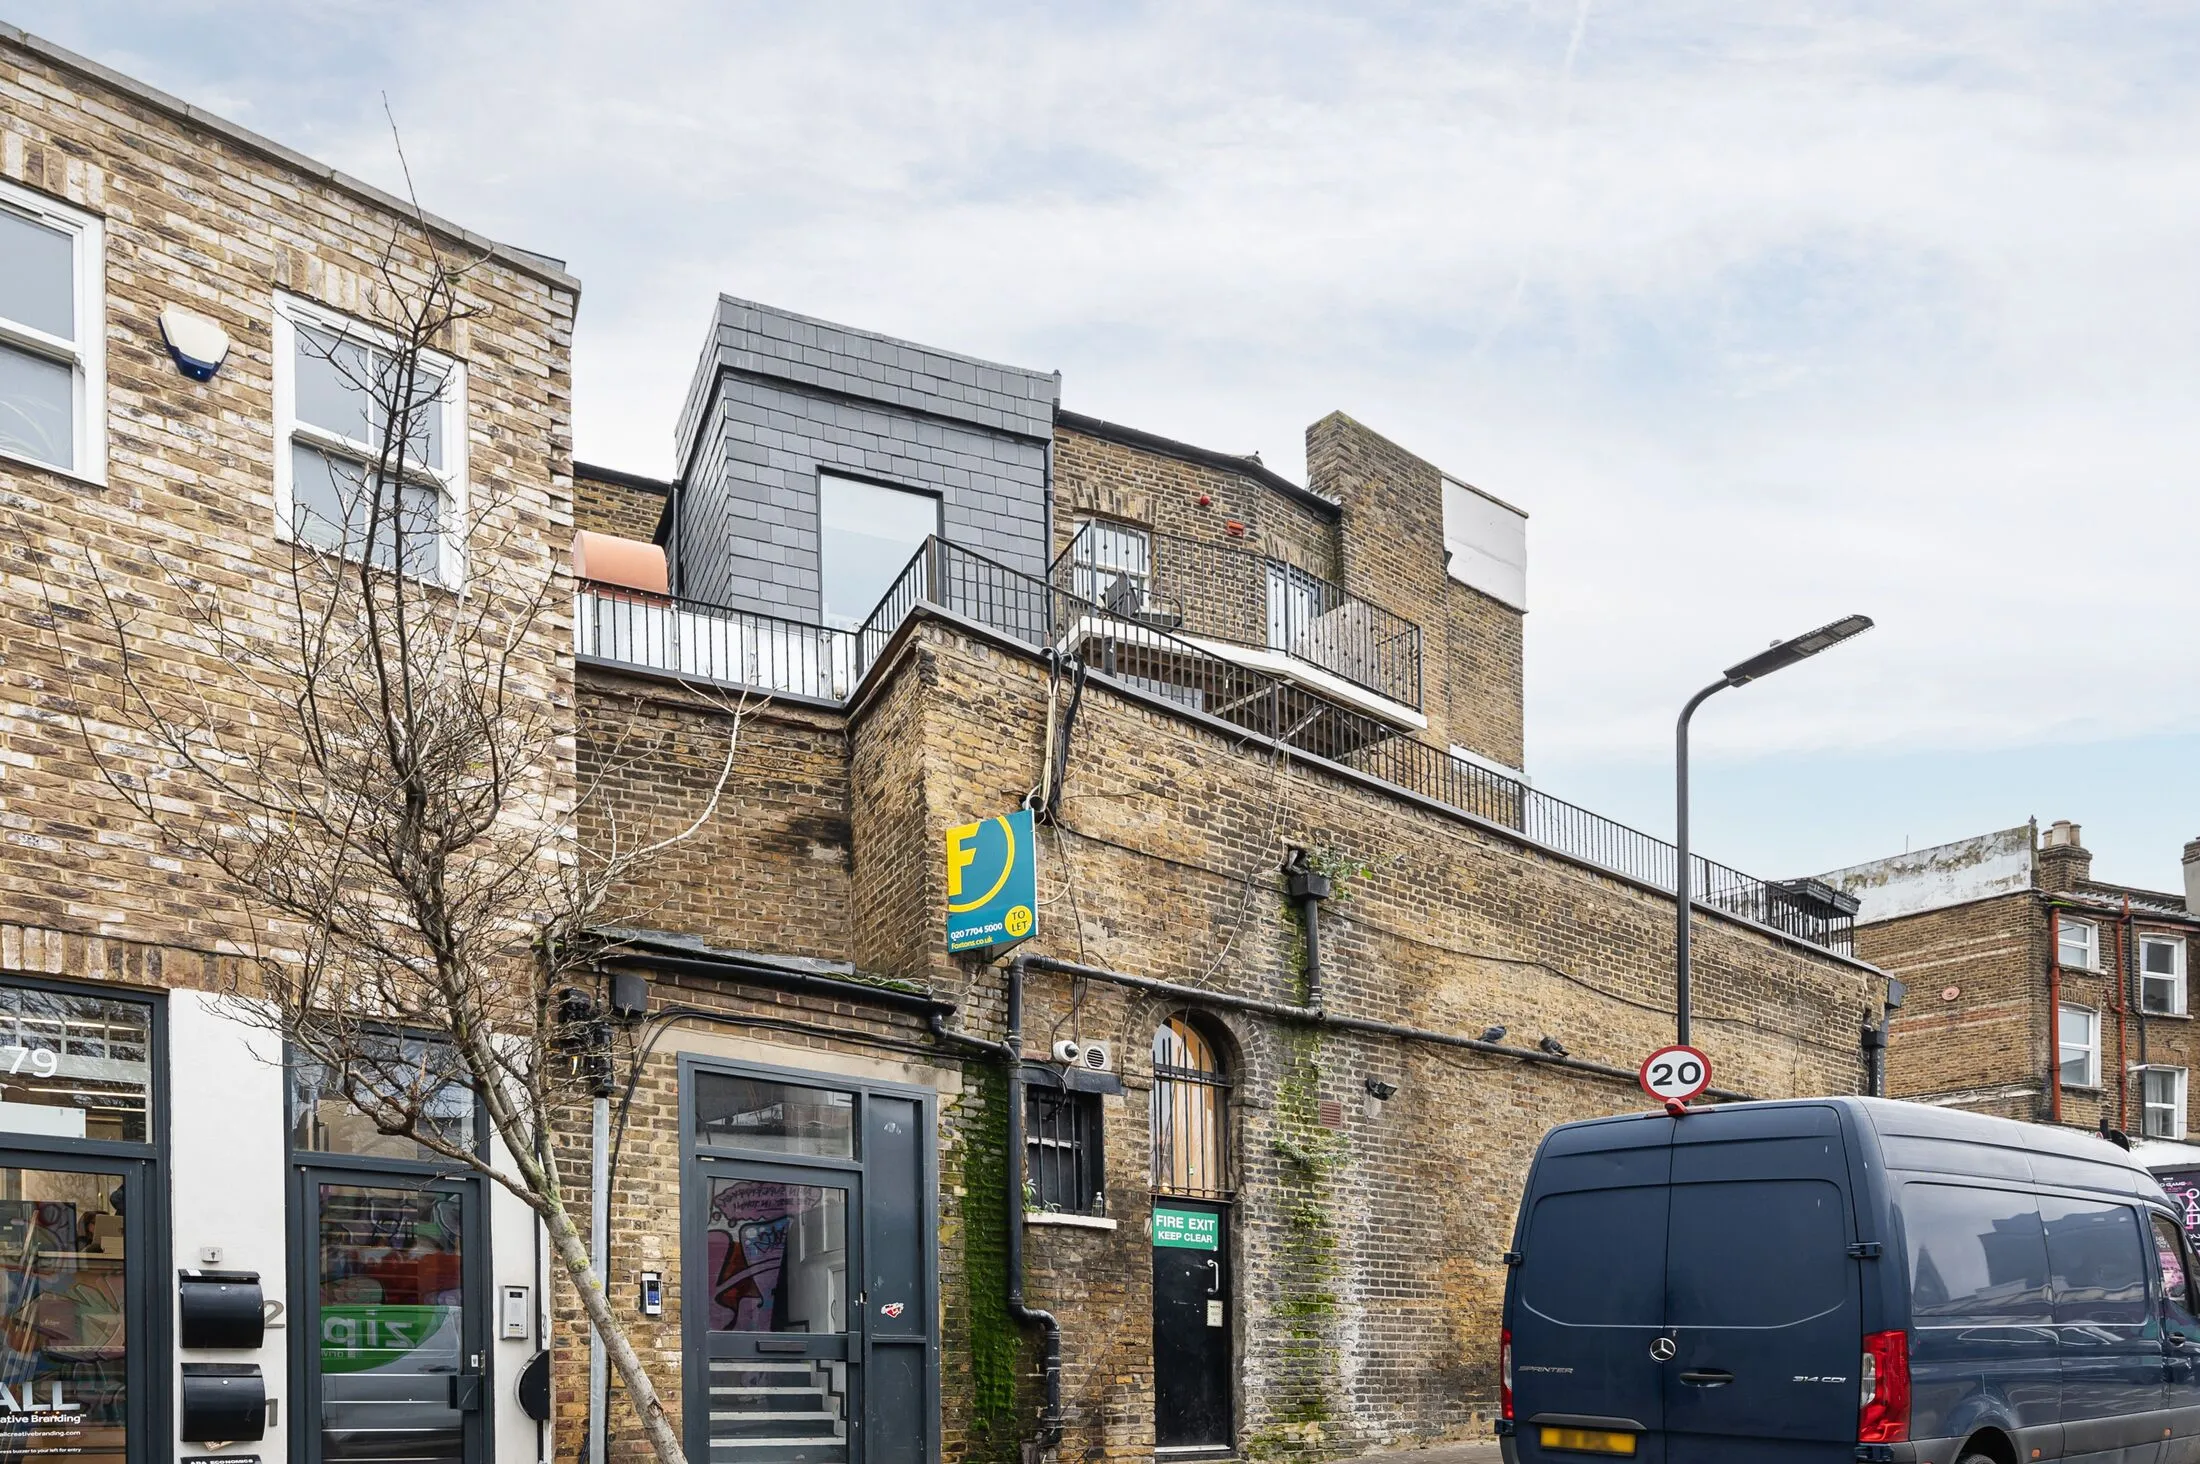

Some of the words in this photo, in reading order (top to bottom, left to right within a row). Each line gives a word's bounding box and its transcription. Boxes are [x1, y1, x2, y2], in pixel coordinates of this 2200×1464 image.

[1012, 910, 1025, 920] TO
[951, 930, 965, 939] 020
[965, 926, 984, 937] 7704
[984, 922, 1003, 933] 5000
[1012, 920, 1028, 932] LET
[3, 1045, 58, 1078] 79
[1652, 1061, 1702, 1086] 20
[1155, 1214, 1184, 1229] FIRE
[1188, 1217, 1215, 1231] EXIT
[1158, 1230, 1182, 1240] KEEP
[1183, 1233, 1213, 1243] CLEAR
[264, 1299, 286, 1329] 2
[1518, 1365, 1574, 1374] SPRINTER
[265, 1398, 278, 1428] 1
